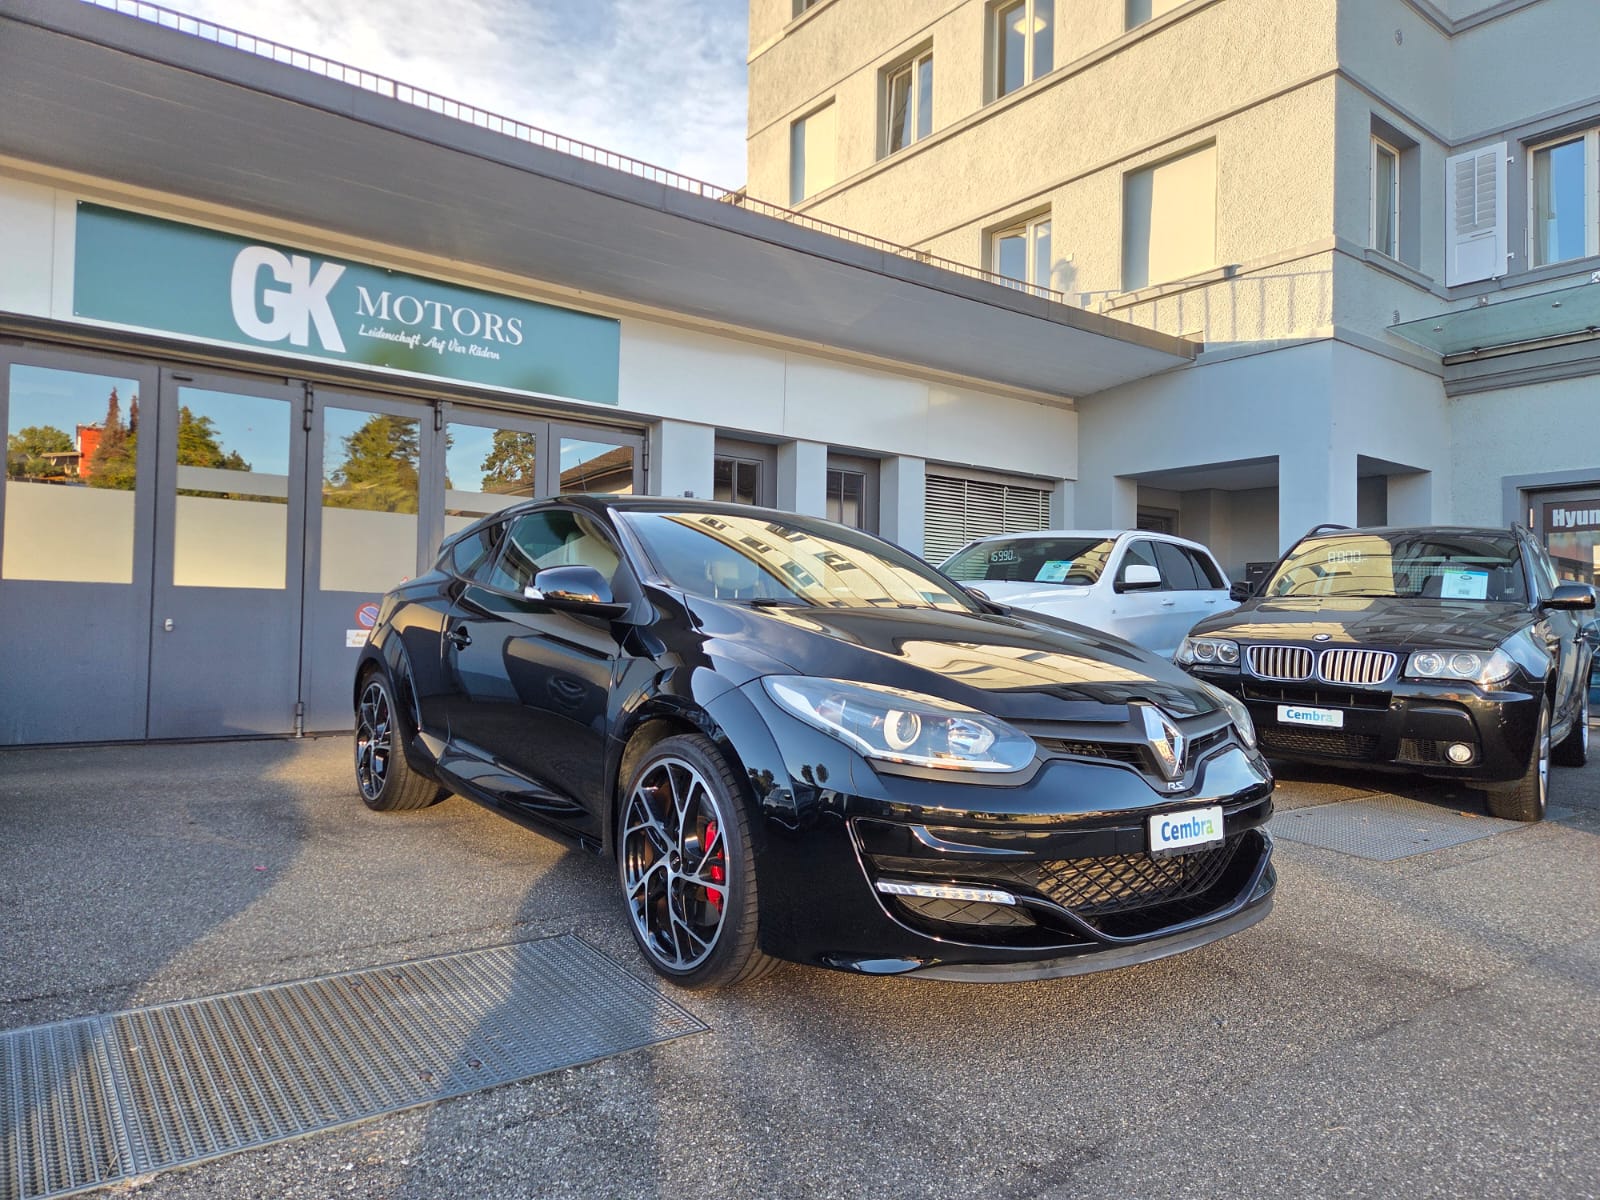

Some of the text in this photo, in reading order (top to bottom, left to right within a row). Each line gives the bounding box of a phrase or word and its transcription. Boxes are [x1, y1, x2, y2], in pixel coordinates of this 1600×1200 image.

[230, 245, 524, 354] GK MOTORS
[358, 323, 421, 349] Leidenschaft
[423, 336, 447, 355] Auf
[1286, 709, 1334, 723] Cembra
[1161, 816, 1215, 842] Cembra
